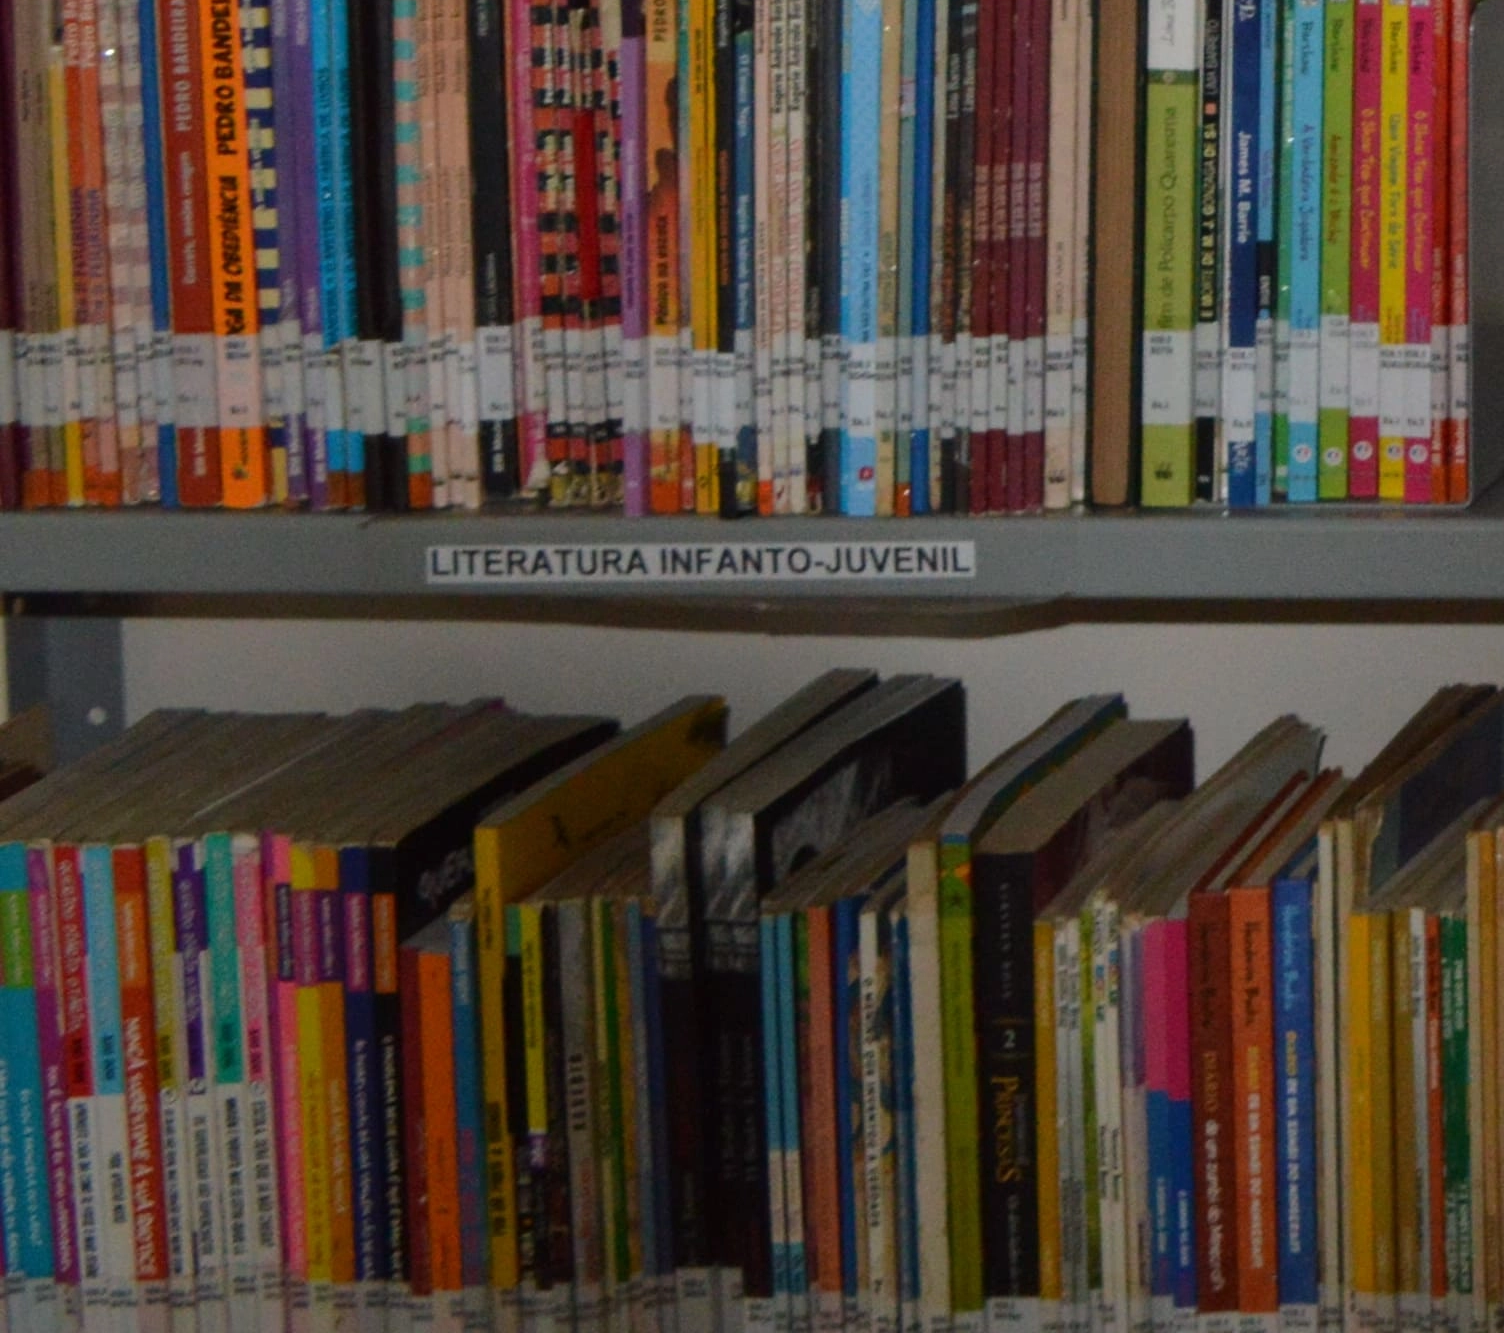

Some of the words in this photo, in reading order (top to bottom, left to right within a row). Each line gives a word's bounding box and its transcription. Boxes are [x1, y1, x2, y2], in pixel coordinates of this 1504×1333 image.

[172, 79, 193, 132] PEDRO
[216, 86, 236, 155] PEDRO
[1160, 106, 1178, 191] Quaresma
[1237, 131, 1251, 175] James
[1238, 180, 1251, 198] M.
[217, 175, 241, 276] OBEDIÊNCIA
[1160, 195, 1178, 272] Policarpo
[1236, 202, 1251, 243] Barrie
[223, 281, 242, 303] DA
[1161, 277, 1174, 297] de
[431, 548, 648, 577] LITERATURA
[660, 547, 971, 573] INFANTO-JUVENIL
